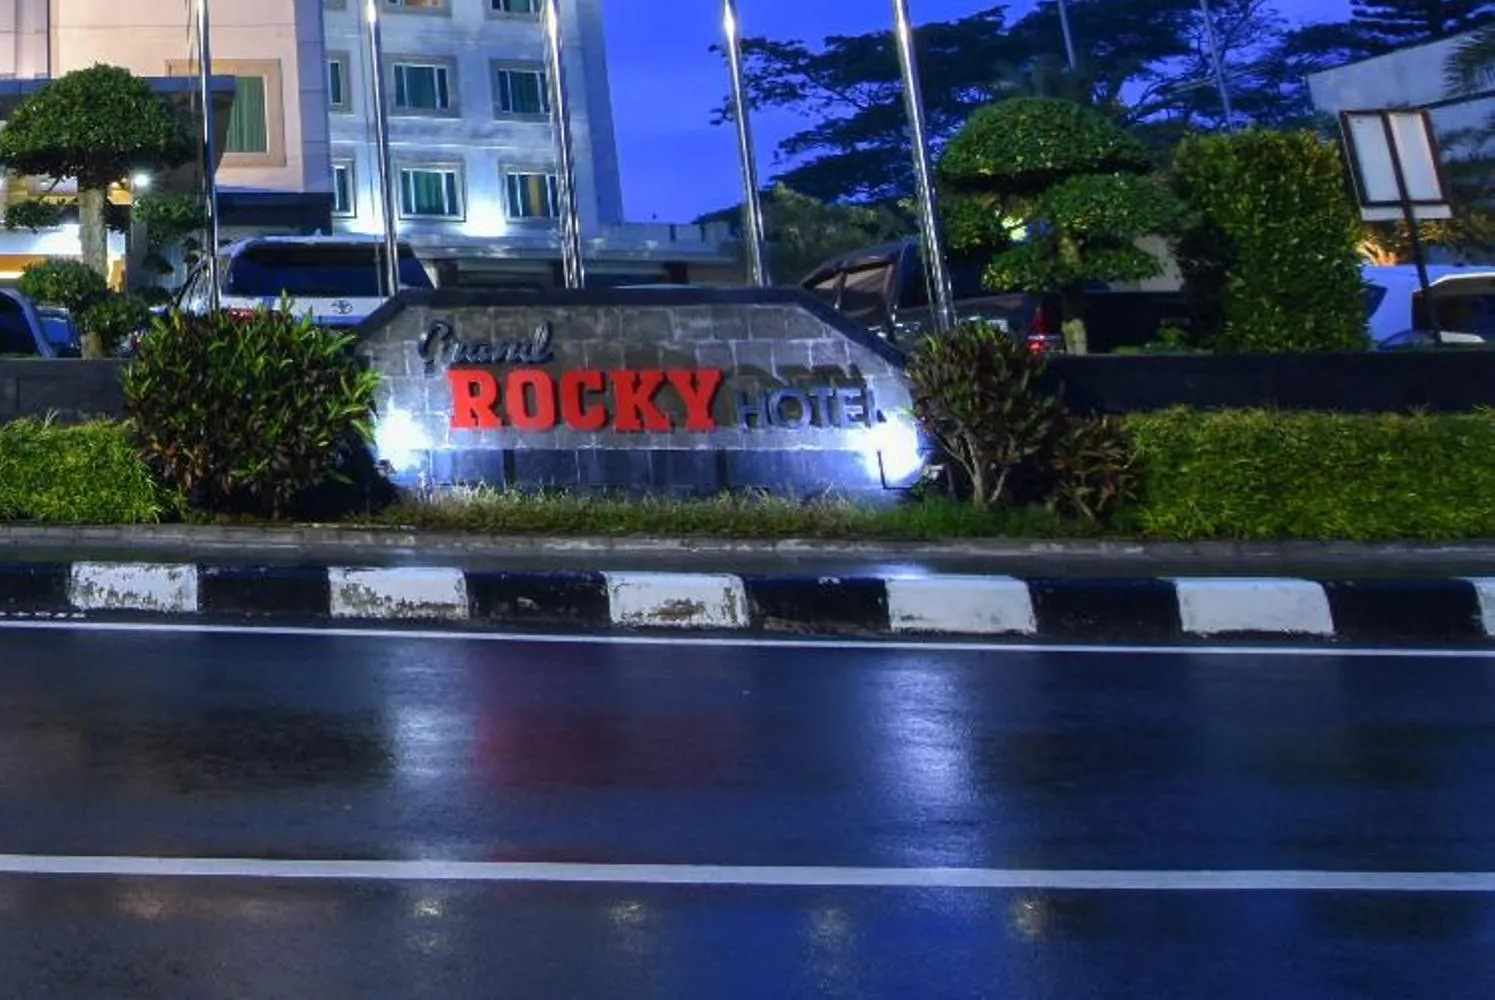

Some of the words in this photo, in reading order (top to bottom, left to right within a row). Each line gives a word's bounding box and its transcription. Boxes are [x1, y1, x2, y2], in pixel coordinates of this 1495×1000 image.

[418, 320, 554, 374] Grand
[447, 369, 723, 431] ROCKY
[734, 384, 886, 431] HOTEL
